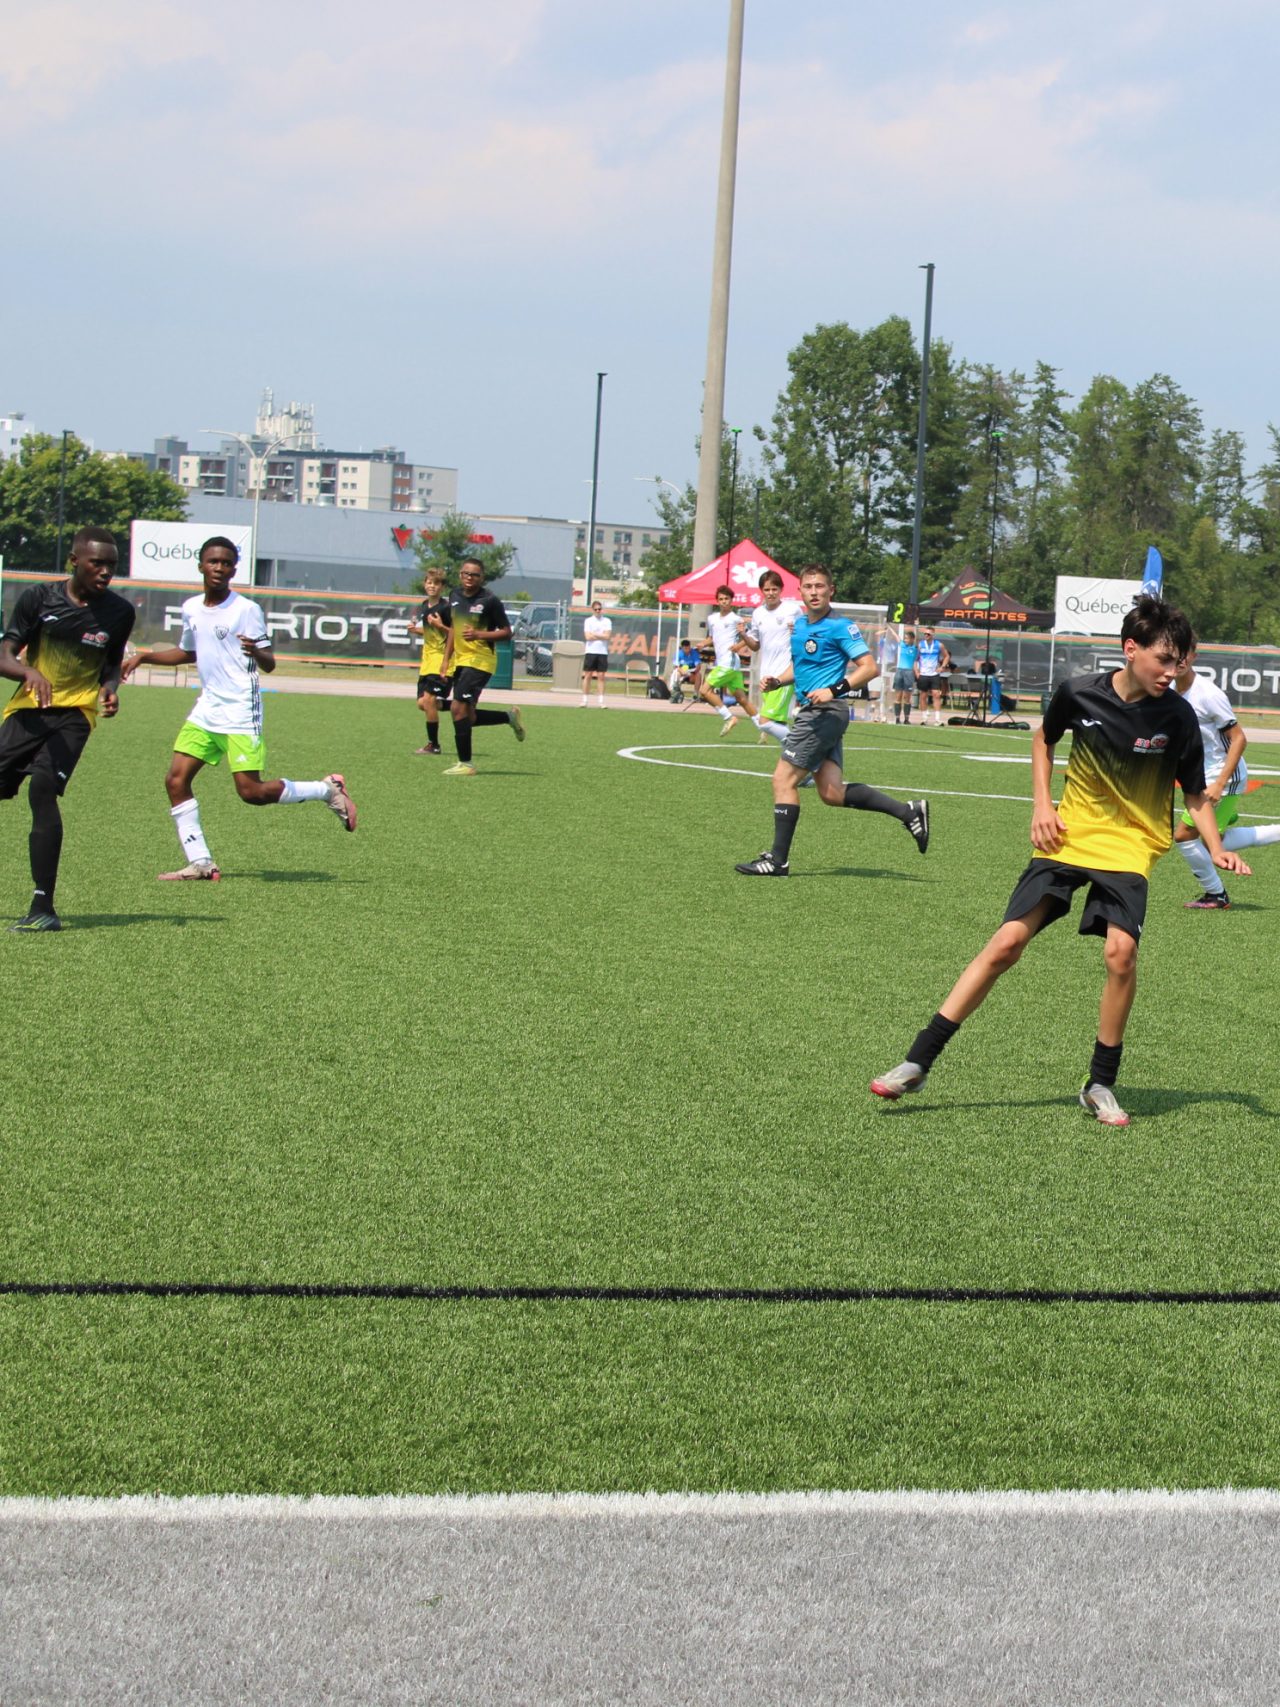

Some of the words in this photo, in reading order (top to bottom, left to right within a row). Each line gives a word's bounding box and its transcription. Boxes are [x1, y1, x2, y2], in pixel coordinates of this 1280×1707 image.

[142, 541, 201, 561] Québe
[1065, 596, 1128, 614] Québec
[944, 609, 1028, 622] PATRIOTES
